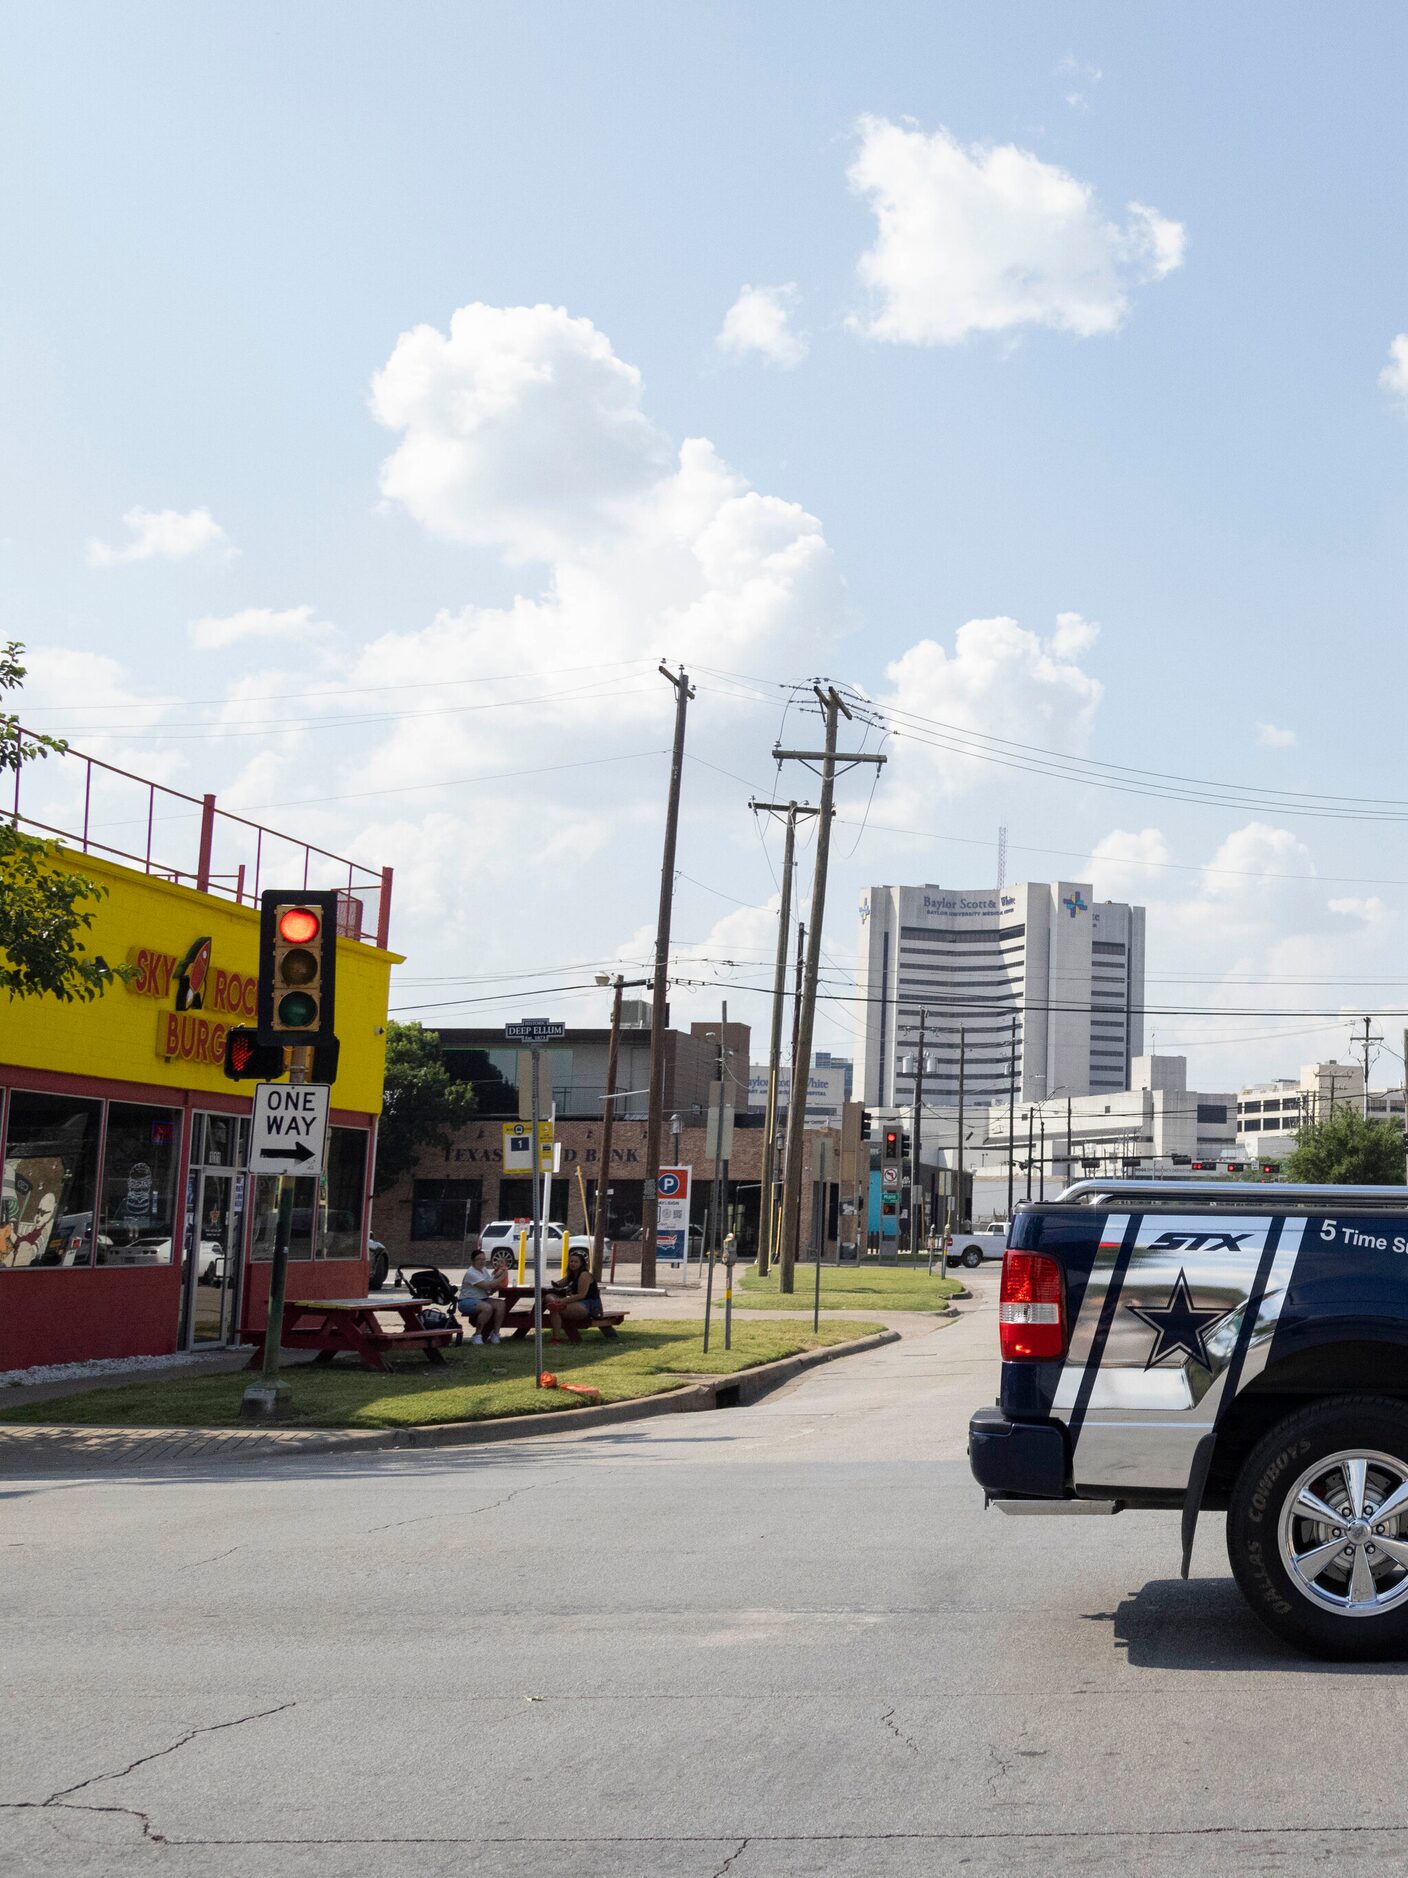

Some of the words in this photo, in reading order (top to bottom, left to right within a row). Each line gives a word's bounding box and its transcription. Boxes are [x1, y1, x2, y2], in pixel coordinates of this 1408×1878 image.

[923, 896, 957, 910] Baylor
[960, 898, 987, 909] Scott
[136, 948, 177, 997] SKY
[166, 1012, 225, 1064] BURG
[508, 1027, 531, 1035] DEEP
[533, 1026, 562, 1034] ELLUM
[267, 1090, 316, 1112] ONE
[267, 1115, 317, 1136] WAY
[444, 1149, 501, 1162] TEXAS
[564, 1150, 577, 1162] D
[1147, 1232, 1255, 1252] STX
[1320, 1219, 1338, 1241] 5
[1342, 1228, 1388, 1251] Time
[1248, 1438, 1312, 1524] COWBOYS
